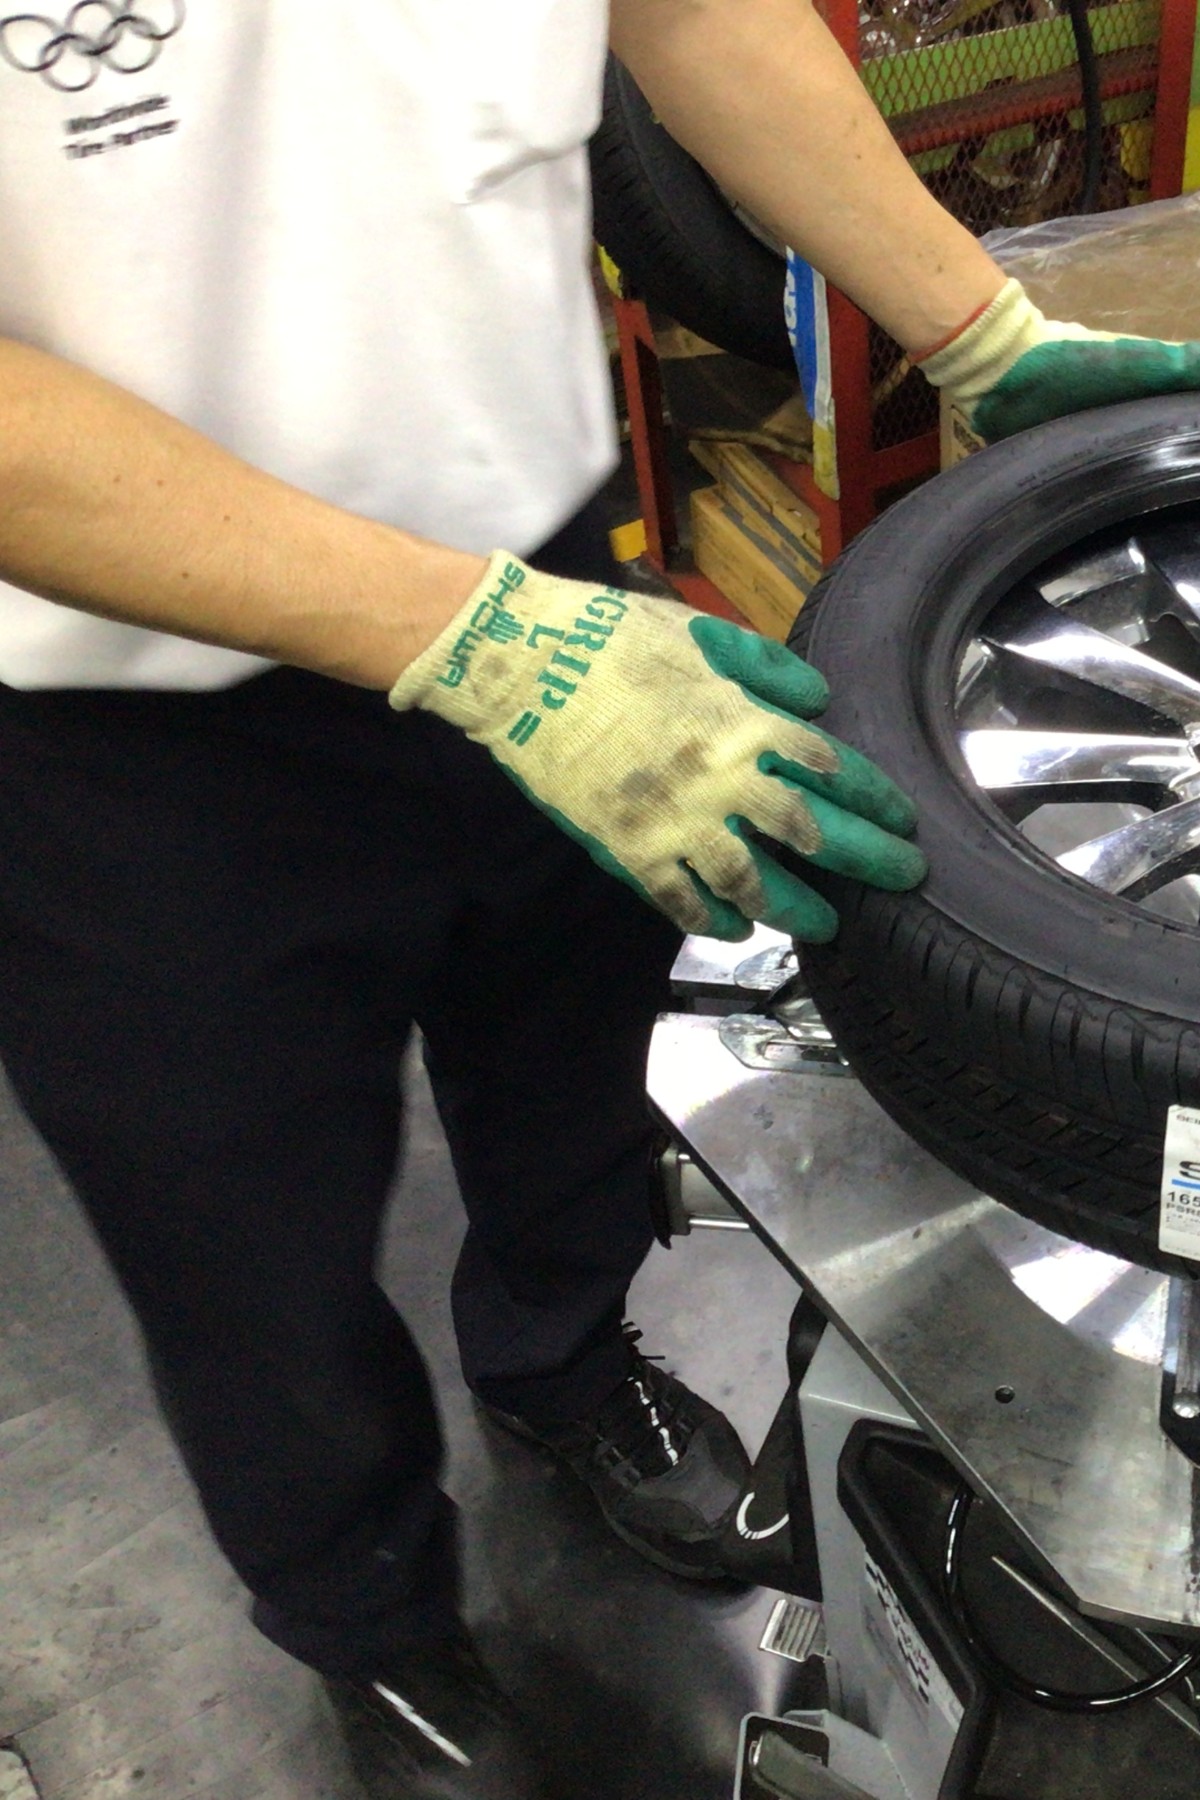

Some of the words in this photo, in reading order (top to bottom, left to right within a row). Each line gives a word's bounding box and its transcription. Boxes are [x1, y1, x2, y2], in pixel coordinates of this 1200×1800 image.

[436, 561, 526, 688] SHOWA
[526, 623, 566, 649] L
[536, 596, 629, 710] GRIP
